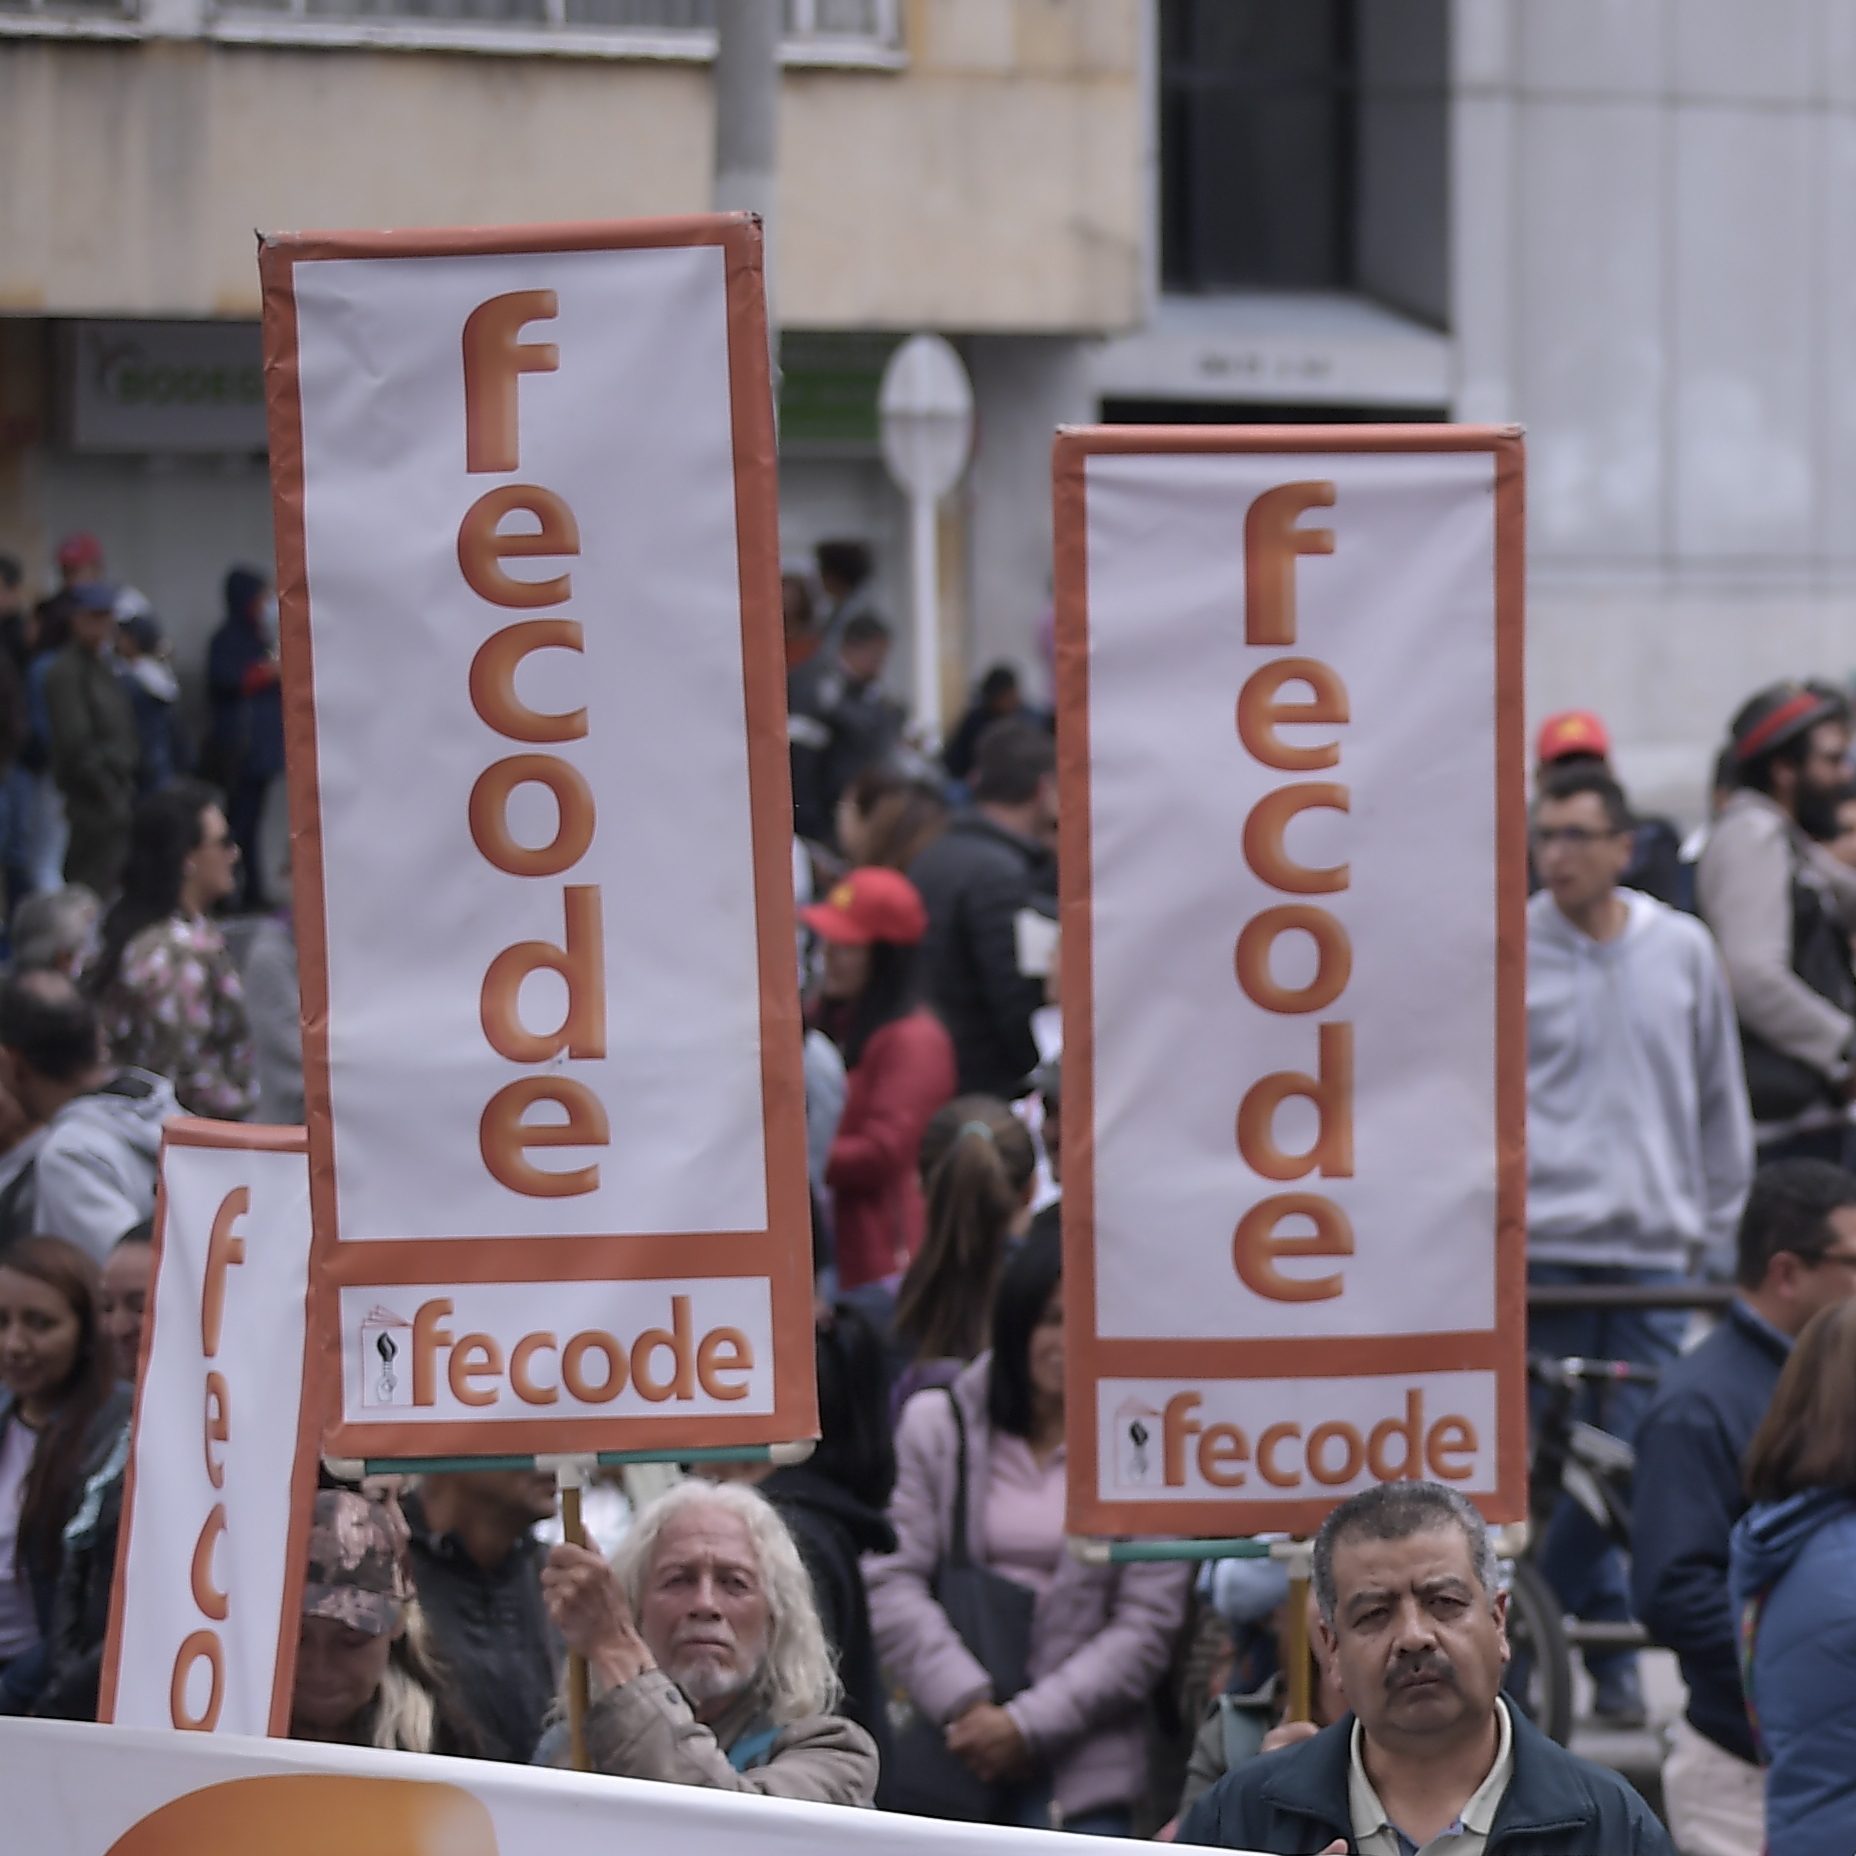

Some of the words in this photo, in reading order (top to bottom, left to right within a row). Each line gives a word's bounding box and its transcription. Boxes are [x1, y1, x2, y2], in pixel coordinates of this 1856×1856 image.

[457, 289, 611, 1198] fecode
[1232, 479, 1356, 1304] fecode
[412, 1295, 754, 1407] fecode
[1163, 1387, 1478, 1488] fecode
